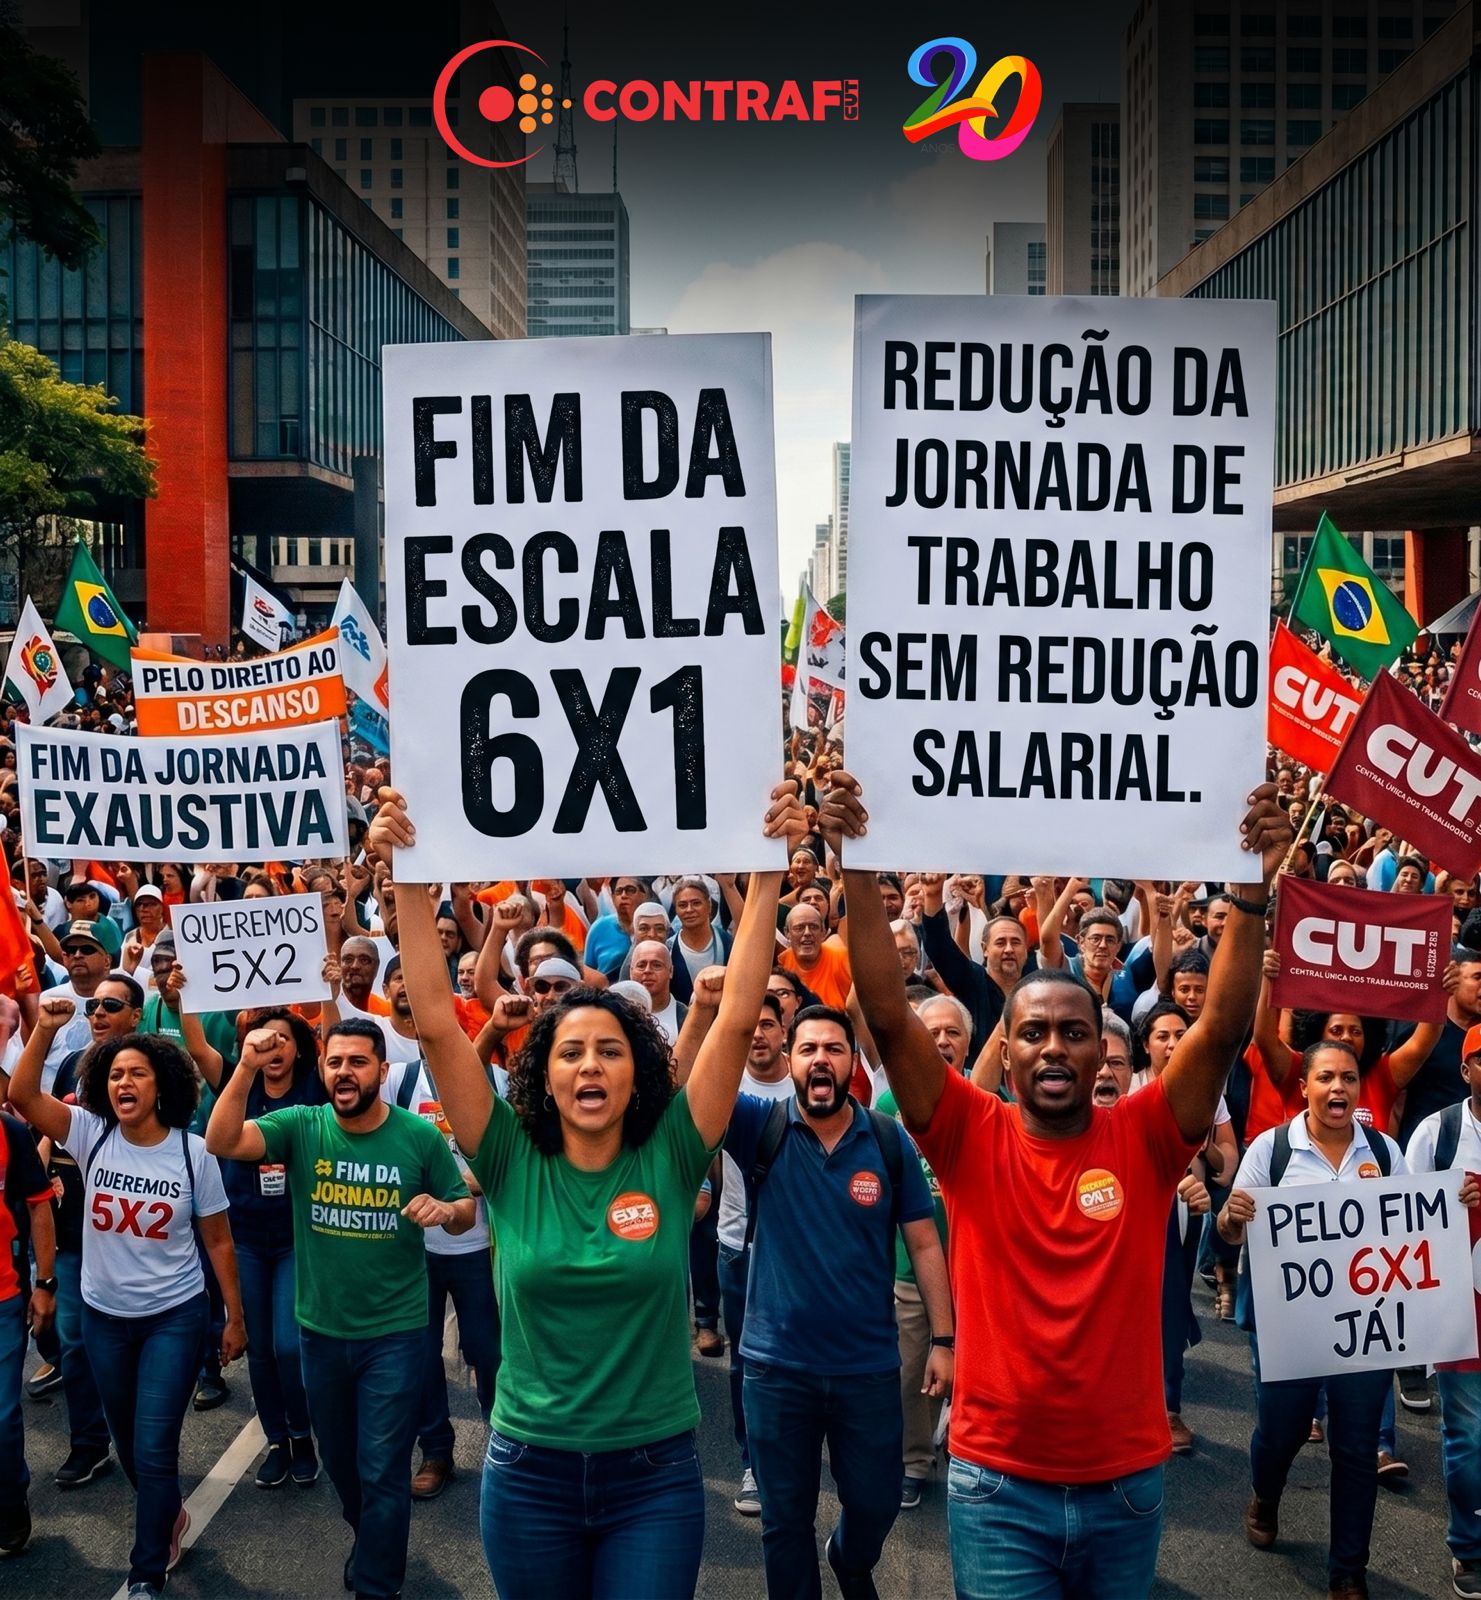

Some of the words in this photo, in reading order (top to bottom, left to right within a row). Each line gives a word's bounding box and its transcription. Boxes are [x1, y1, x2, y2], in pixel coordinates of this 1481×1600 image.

[884, 329, 1152, 428] REDUÇÃO
[1173, 347, 1248, 417] DA
[413, 393, 583, 507] FIM
[621, 388, 746, 500] DA
[886, 439, 1152, 512] JORNADA
[1172, 445, 1245, 515] DE
[404, 527, 765, 645] ESCALA
[908, 536, 1213, 611] TRABALHO
[143, 667, 205, 692] PELO
[212, 656, 301, 690] DIREITO
[309, 648, 335, 676] AO
[859, 632, 977, 701] SEM
[998, 624, 1258, 720] REDUÇÃO
[1274, 664, 1361, 734] CUT
[177, 686, 320, 731] DESCANSO
[31, 744, 90, 781] FIM
[100, 748, 147, 784] DA
[155, 742, 326, 785] JORNADA
[460, 665, 706, 837] 6X1
[912, 729, 1201, 802] SALARIAL.
[1366, 724, 1481, 822] CUT
[34, 789, 334, 849] EXAUSTIVA
[181, 906, 318, 943] QUEREMOS
[1292, 917, 1425, 976] CUT
[212, 943, 301, 992] 5X2
[1324, 968, 1348, 982] ÚNICA
[1349, 976, 1365, 984] DOS
[1366, 977, 1429, 990] TRABALHADORES
[95, 1168, 181, 1199] QUEREMOS
[311, 1181, 400, 1208] JORNADA
[337, 1161, 369, 1182] FIM
[376, 1165, 401, 1184] DA
[91, 1193, 174, 1240] 5X2
[311, 1204, 399, 1231] EXAUSTIVA
[1267, 1199, 1364, 1247] PELO
[1379, 1189, 1448, 1236] FIM
[1281, 1258, 1333, 1301] DO
[1349, 1240, 1441, 1296] 6X1
[1333, 1298, 1405, 1358] JÁ!
